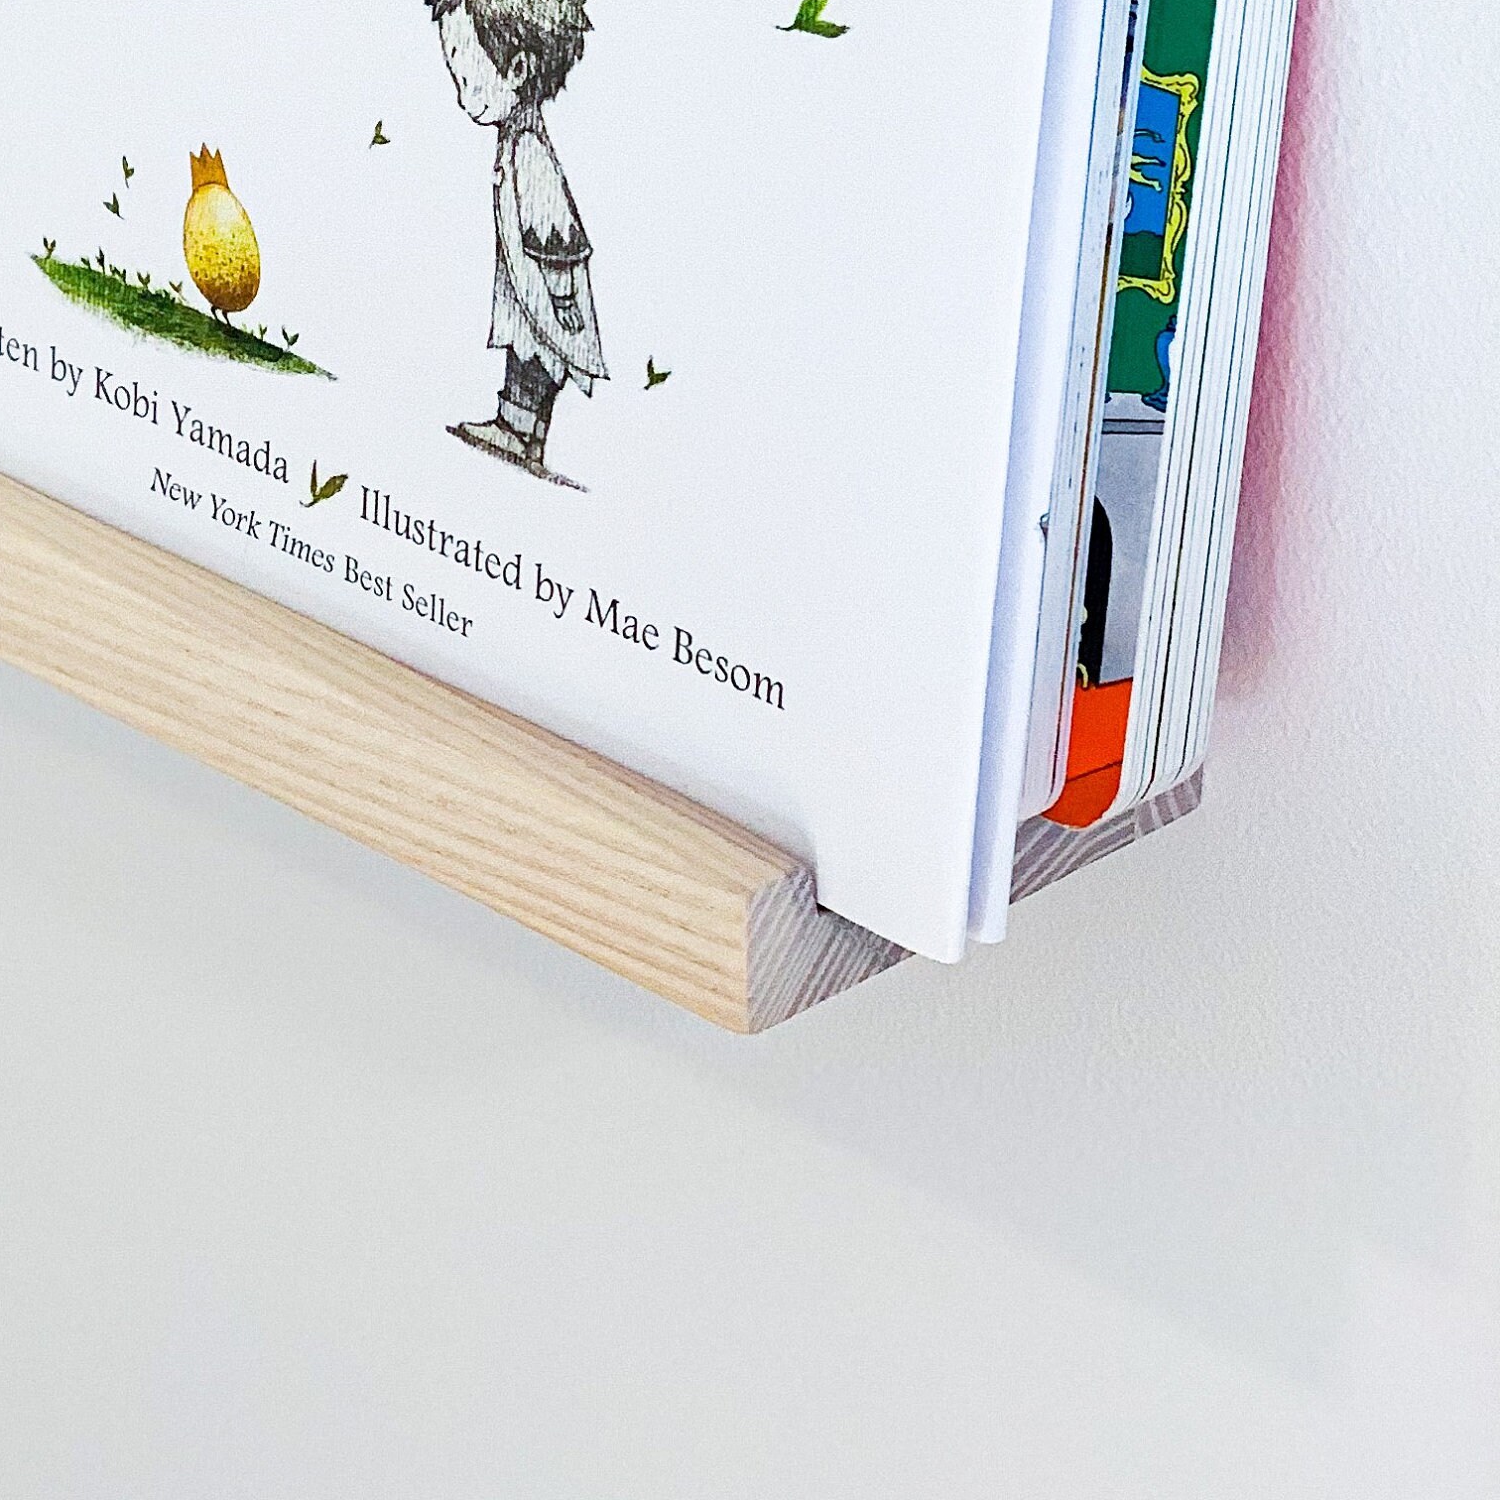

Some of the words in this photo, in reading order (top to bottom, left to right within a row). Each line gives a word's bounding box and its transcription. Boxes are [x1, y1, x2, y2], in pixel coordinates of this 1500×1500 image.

[50, 346, 83, 397] by
[94, 366, 159, 425] Kobi
[171, 400, 290, 484] Yamada
[359, 485, 523, 590] Illustrated
[534, 563, 575, 618] by
[584, 588, 660, 651] Mae
[672, 626, 786, 711] Besom
[150, 467, 202, 510] New
[210, 493, 262, 539] York
[269, 520, 335, 573] Times
[344, 555, 393, 602] Best
[401, 583, 473, 638] Seller
